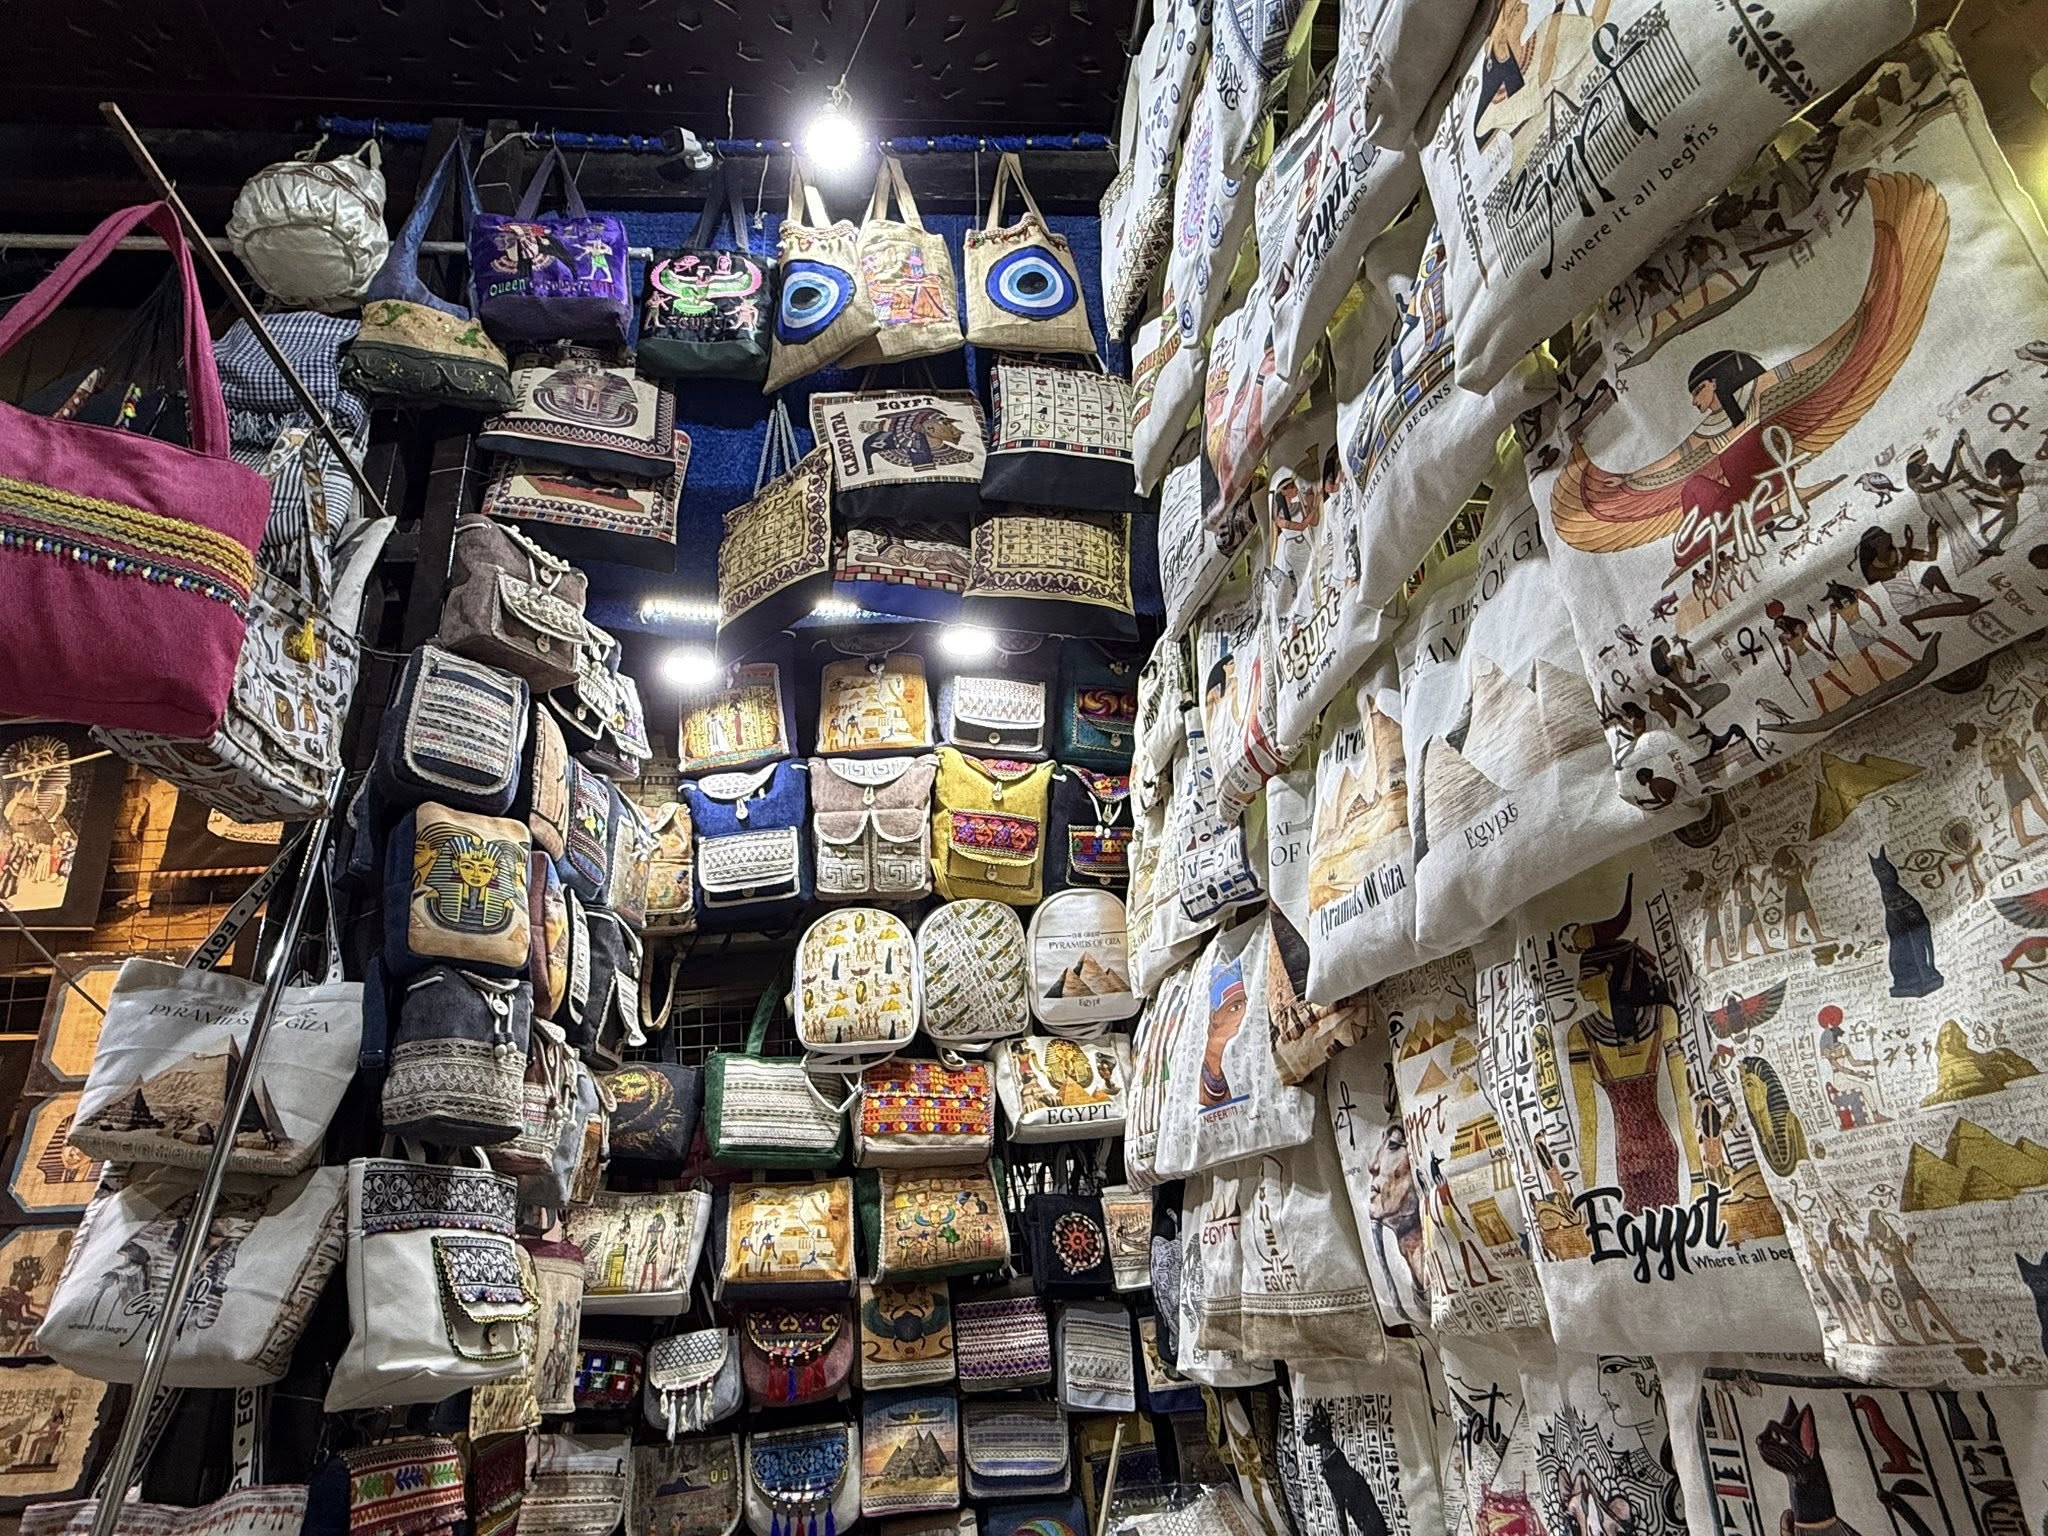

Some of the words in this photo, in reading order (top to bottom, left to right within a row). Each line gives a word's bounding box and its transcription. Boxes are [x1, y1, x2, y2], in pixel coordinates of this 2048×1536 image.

[1561, 222, 1611, 272] where
[1612, 205, 1630, 222] it
[1634, 179, 1657, 205] all
[1657, 120, 1719, 180] begins
[877, 397, 934, 411] EGYPT
[830, 411, 860, 477] CLEOPATRA
[1380, 456, 1391, 475] IT
[1389, 434, 1405, 461] ALL
[1405, 383, 1452, 434] BEGINS
[1278, 586, 1341, 684] Egypt
[1464, 799, 1519, 850] Egypt
[1271, 842, 1302, 867] OF
[249, 858, 291, 905] GYPT
[1320, 885, 1364, 940] Pyramids
[1363, 869, 1382, 910] Of
[1377, 862, 1408, 901] Giza
[197, 920, 239, 970] EGYP
[149, 1004, 250, 1026] PYRAMIDS
[285, 1018, 330, 1034] GIZA
[1047, 1104, 1111, 1125] EGYPT
[739, 1218, 780, 1235] Egypt
[1203, 1222, 1240, 1246] EGYPT
[1572, 1183, 1732, 1284] Egypt
[1692, 1254, 1734, 1270] Where
[1739, 1252, 1748, 1265] it
[1752, 1250, 1767, 1264] all
[1767, 1246, 1796, 1262] beg
[1263, 1272, 1301, 1292] EGYPT
